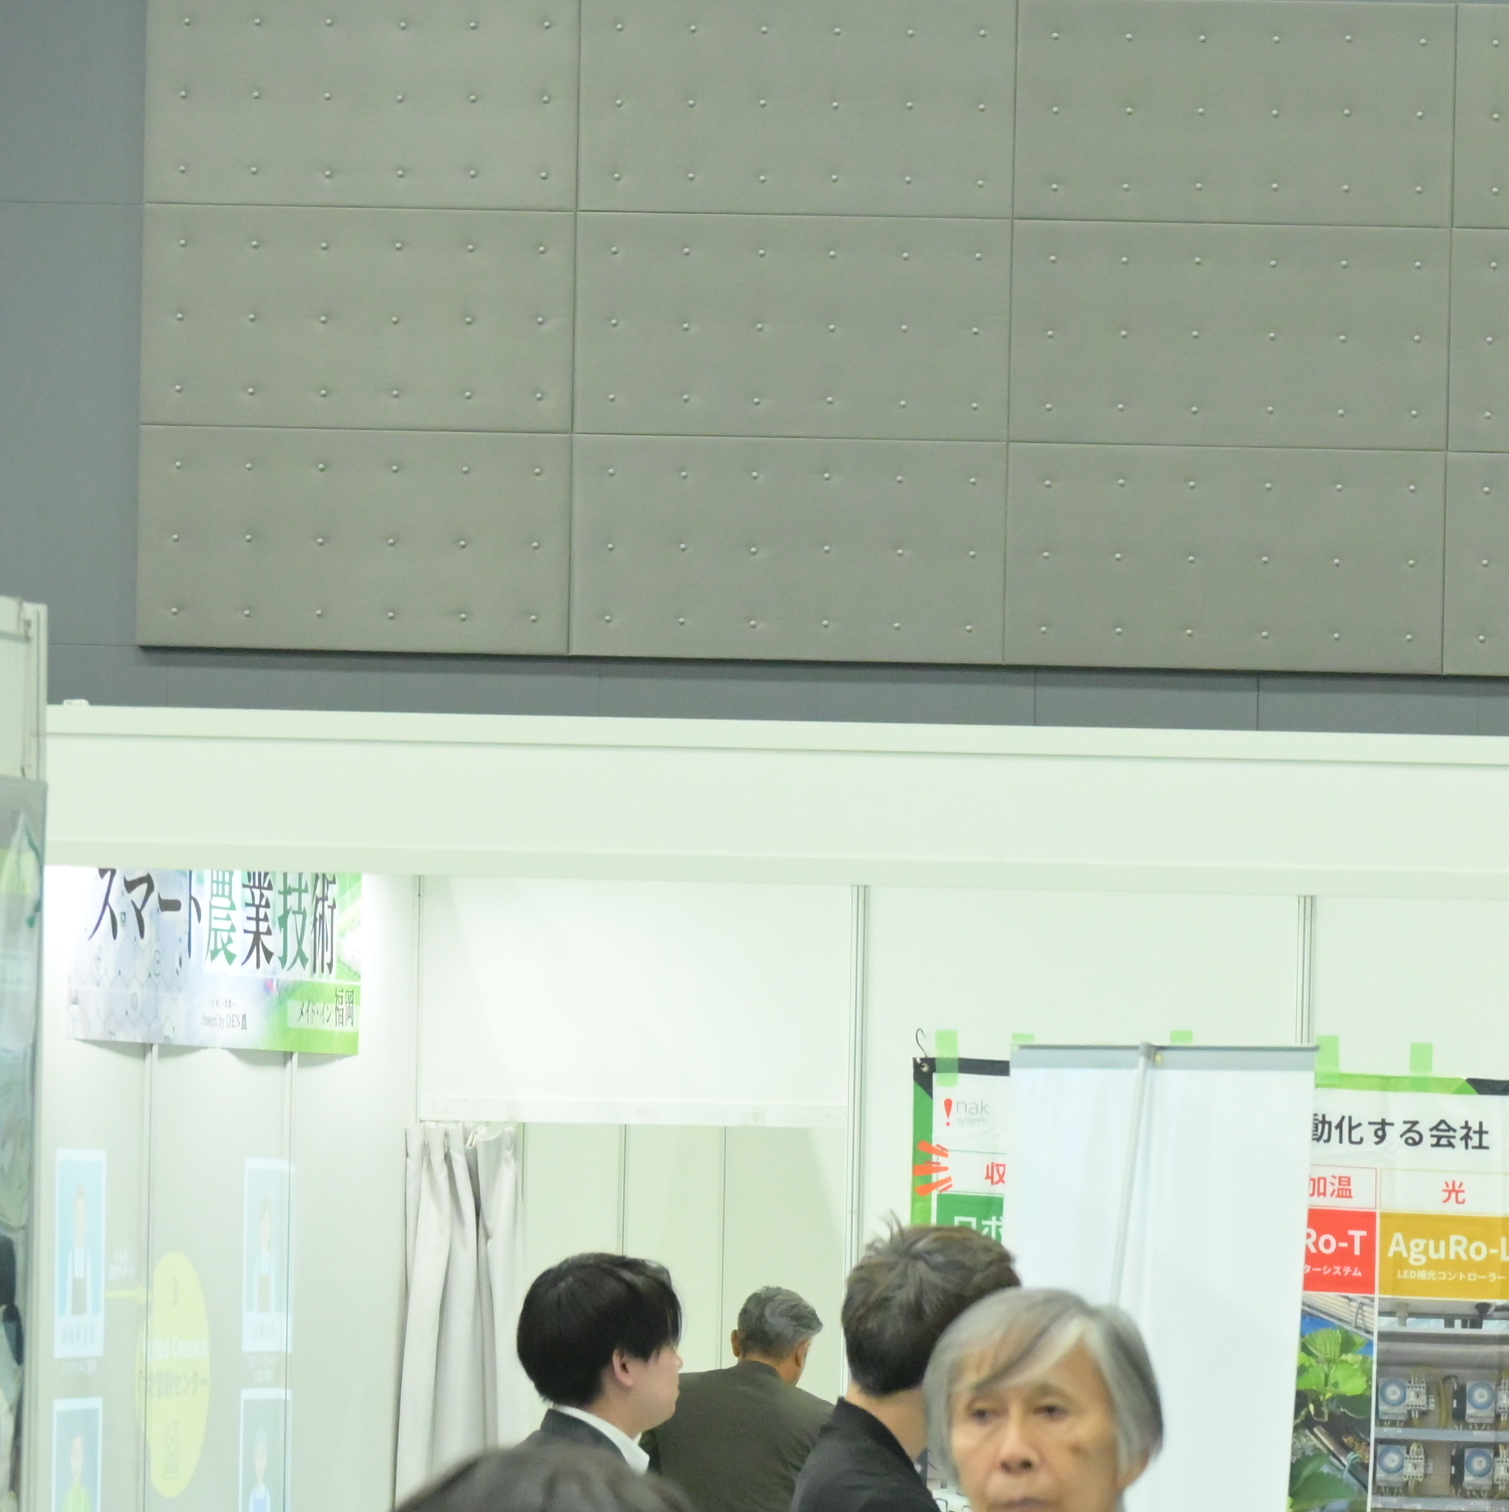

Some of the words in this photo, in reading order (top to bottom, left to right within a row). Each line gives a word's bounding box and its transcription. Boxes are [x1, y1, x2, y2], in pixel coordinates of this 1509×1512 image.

[88, 867, 337, 975] スマート農業技術
[1311, 1111, 1490, 1151] 動化する会社
[1308, 1174, 1354, 1199] 加温
[1442, 1180, 1466, 1205] 光
[1397, 1269, 1506, 1283] LED補光コントローラー
